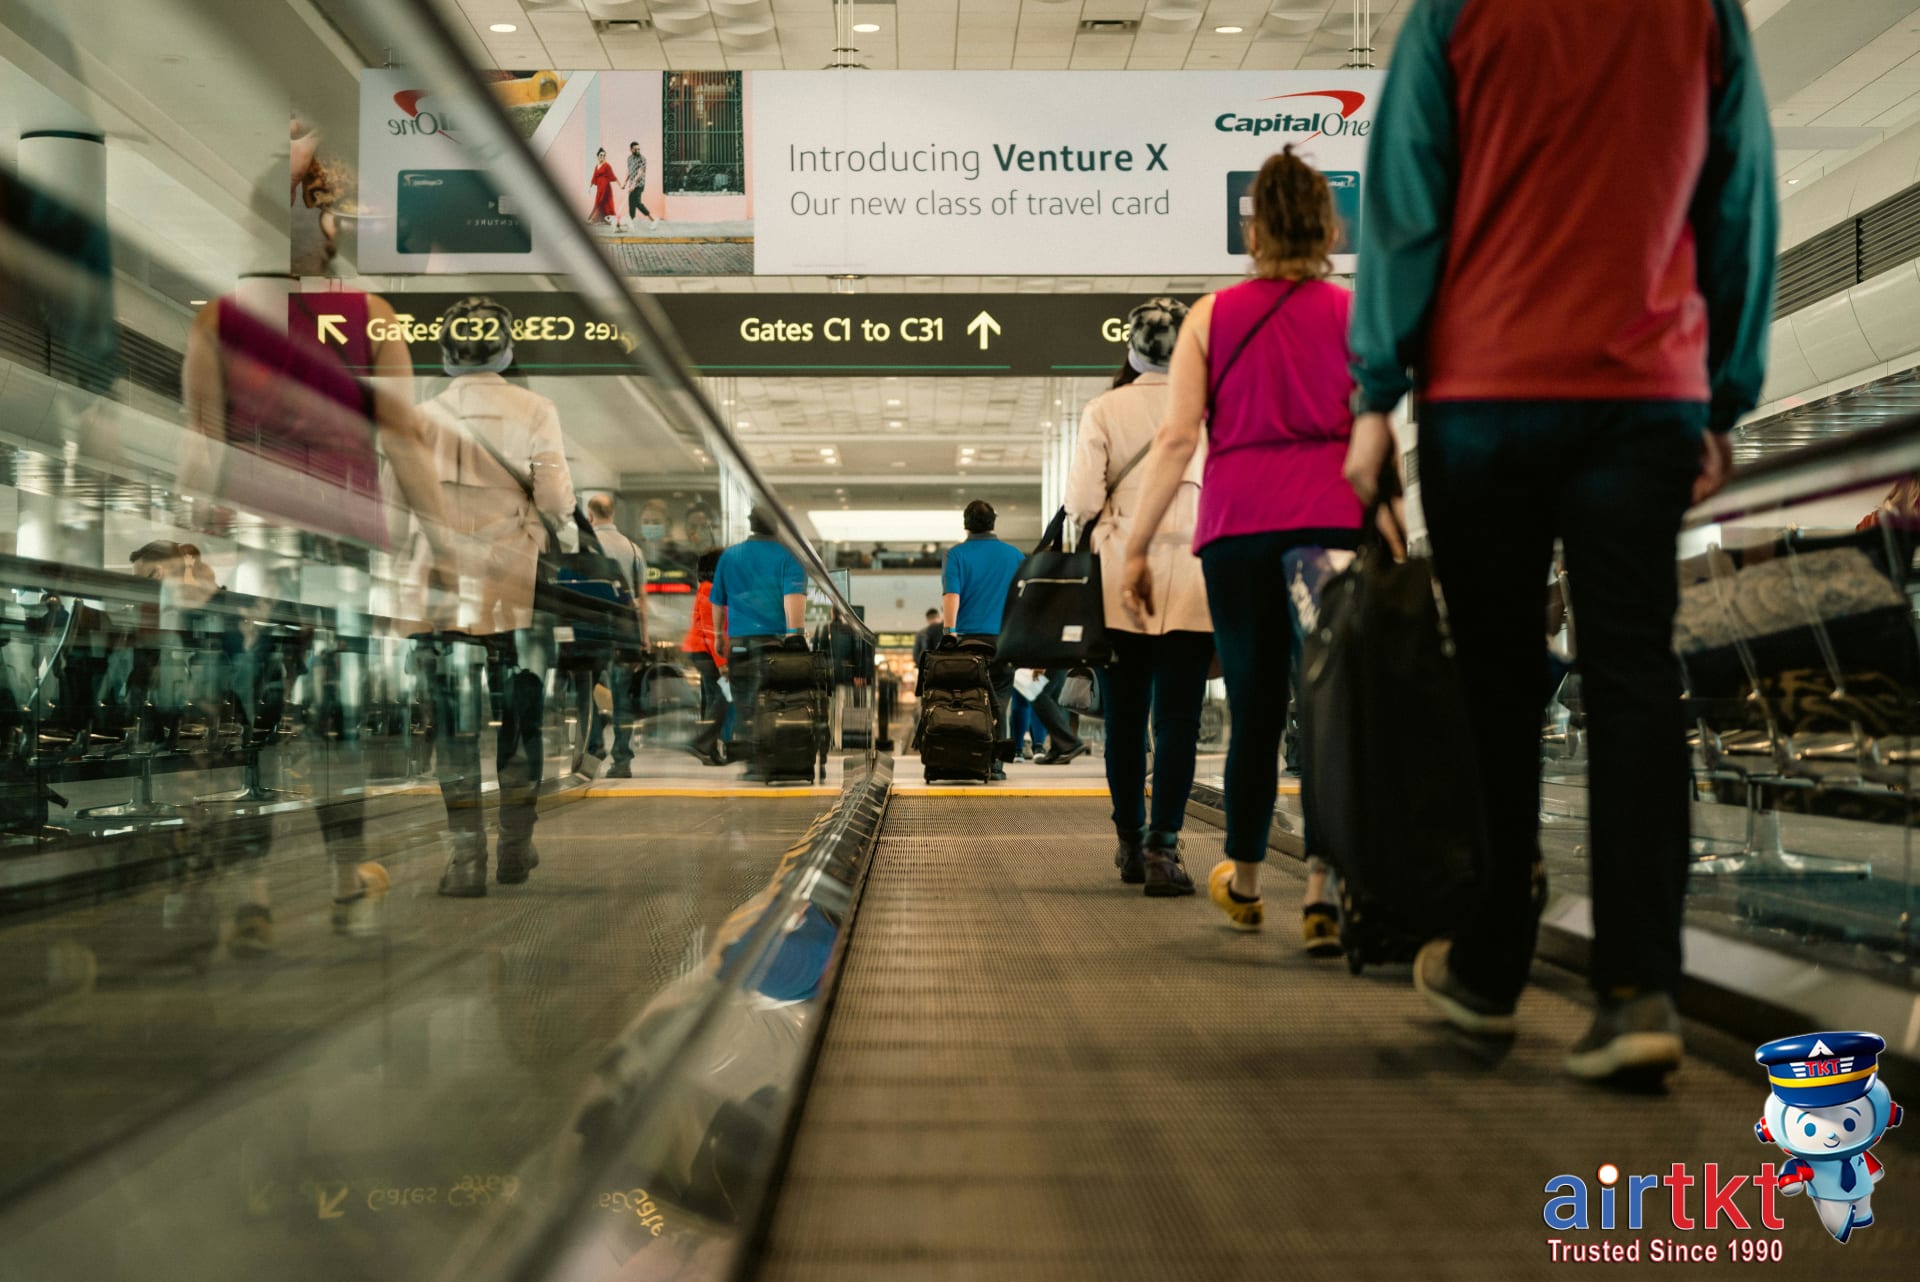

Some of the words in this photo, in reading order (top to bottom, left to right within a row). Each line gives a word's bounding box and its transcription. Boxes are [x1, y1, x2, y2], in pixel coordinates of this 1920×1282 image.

[790, 142, 980, 180] Introducing
[993, 143, 1133, 172] Venture
[1145, 143, 1169, 172] X
[790, 191, 840, 215] Our
[850, 200, 906, 215] new
[916, 190, 982, 215] class
[991, 190, 1018, 215] of
[1028, 190, 1101, 215] travel
[1112, 190, 1170, 215] card
[366, 317, 442, 342] Gates
[450, 317, 500, 342] C32
[739, 317, 814, 342] Gates
[823, 317, 851, 342] C1
[861, 318, 891, 342] to
[899, 317, 944, 342] C31
